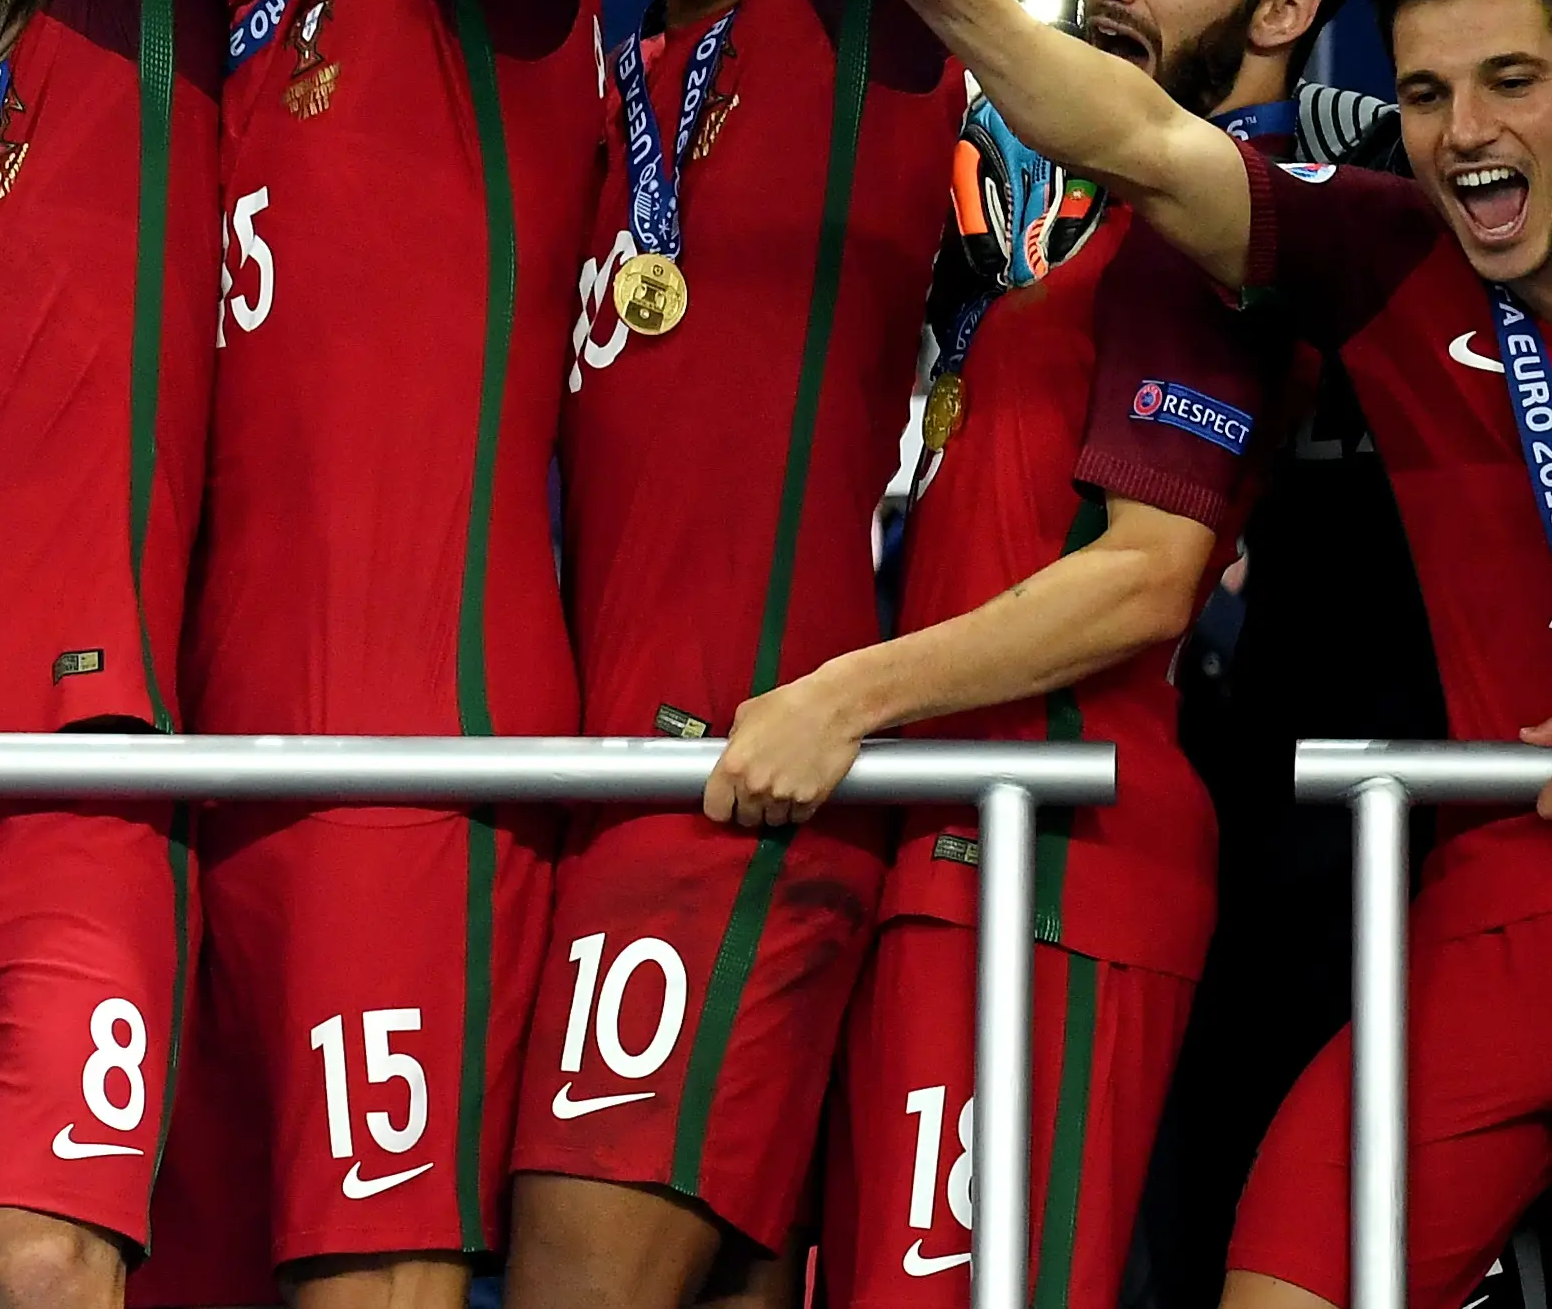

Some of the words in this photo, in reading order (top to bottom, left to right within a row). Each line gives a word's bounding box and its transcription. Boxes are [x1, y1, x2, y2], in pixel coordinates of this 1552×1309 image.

[625, 74, 653, 166] UEFA
[676, 66, 708, 155] 2016
[1162, 393, 1251, 444] RESPECT
[1507, 334, 1552, 433] EURO
[560, 932, 688, 1079] 10
[81, 997, 149, 1132] 8
[310, 1007, 430, 1160] 15
